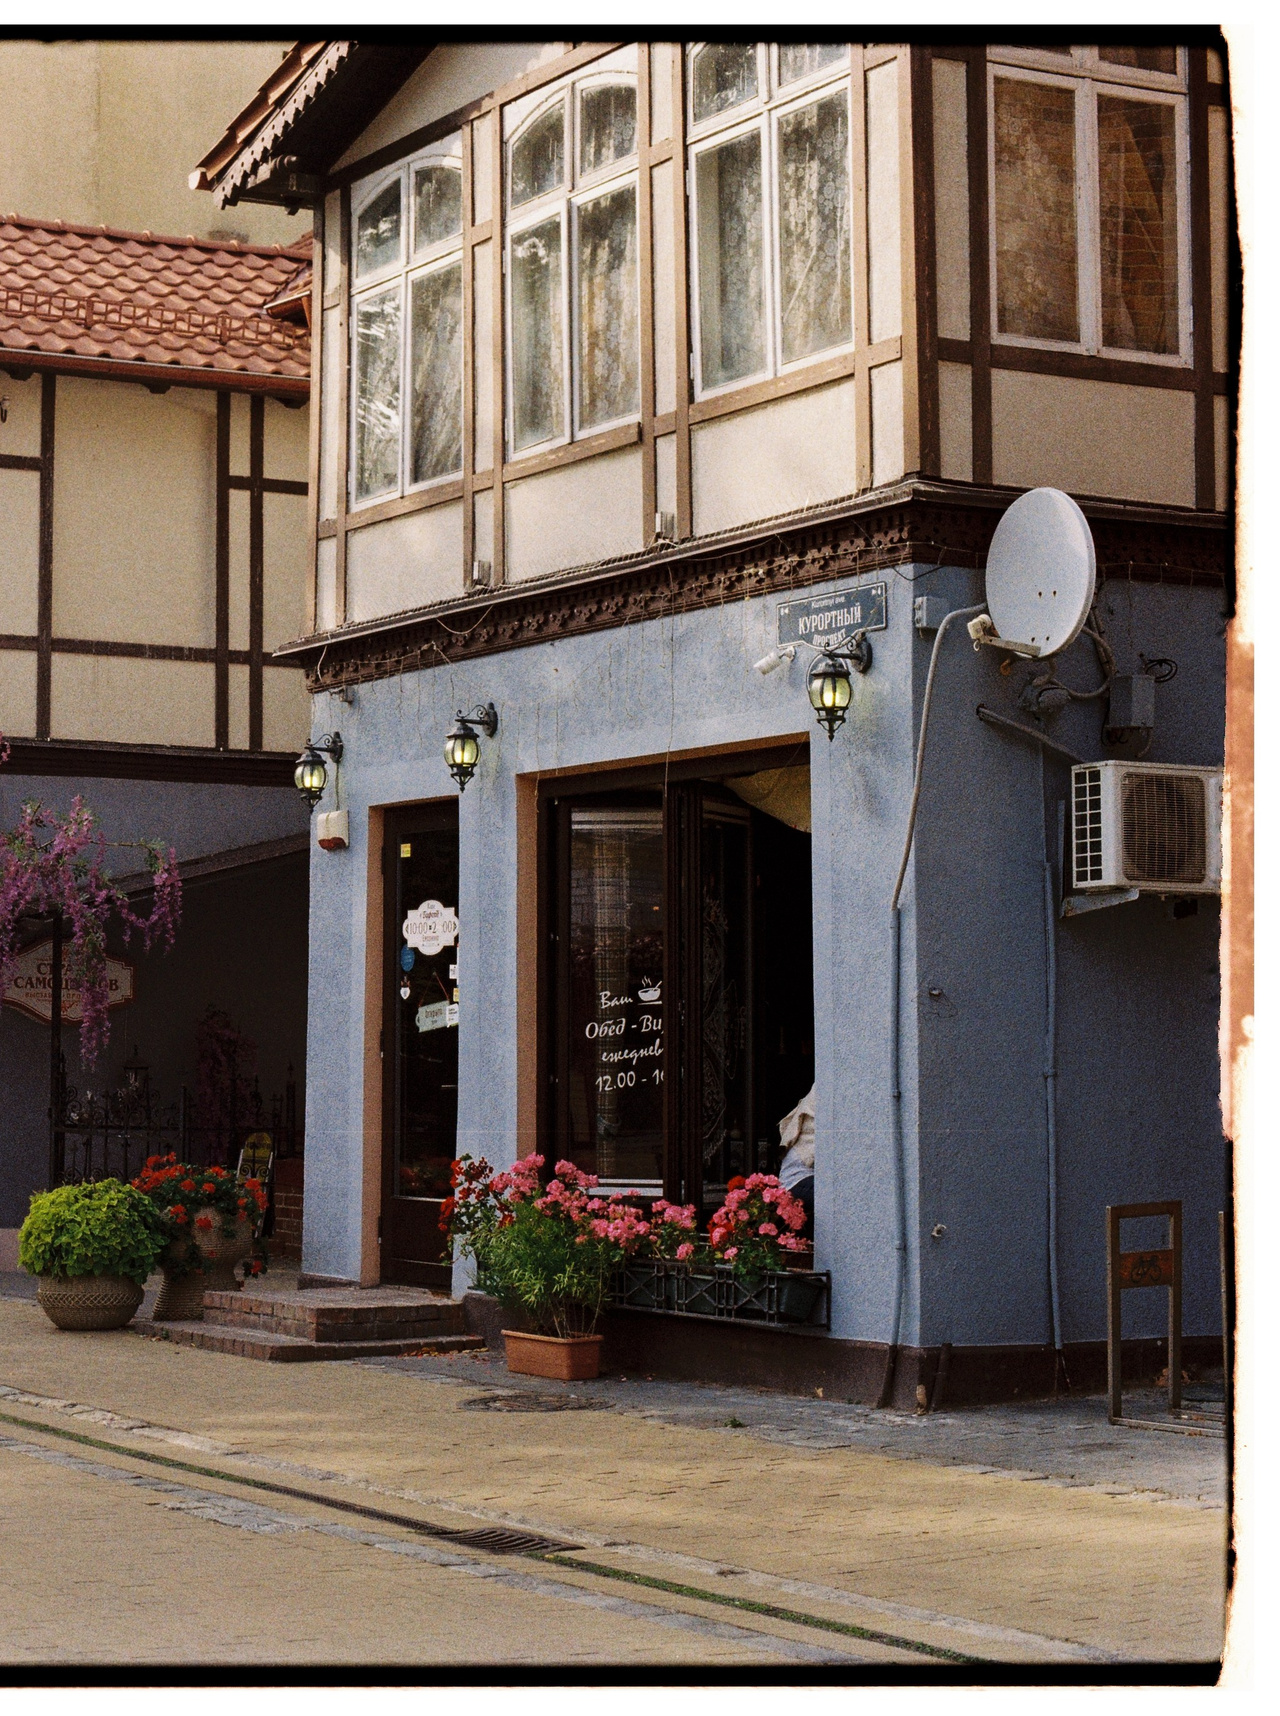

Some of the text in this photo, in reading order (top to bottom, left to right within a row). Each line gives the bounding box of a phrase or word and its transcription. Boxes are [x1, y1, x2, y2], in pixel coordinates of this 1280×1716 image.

[798, 602, 862, 635] КУРОРТНЫЙ
[812, 628, 846, 646] ПРОСПЕКТ
[599, 990, 634, 1009] Ваш
[585, 1017, 626, 1039] Обед
[638, 1014, 664, 1035] Ви
[601, 1037, 664, 1066] ежеднев
[595, 1070, 636, 1092] 12.00
